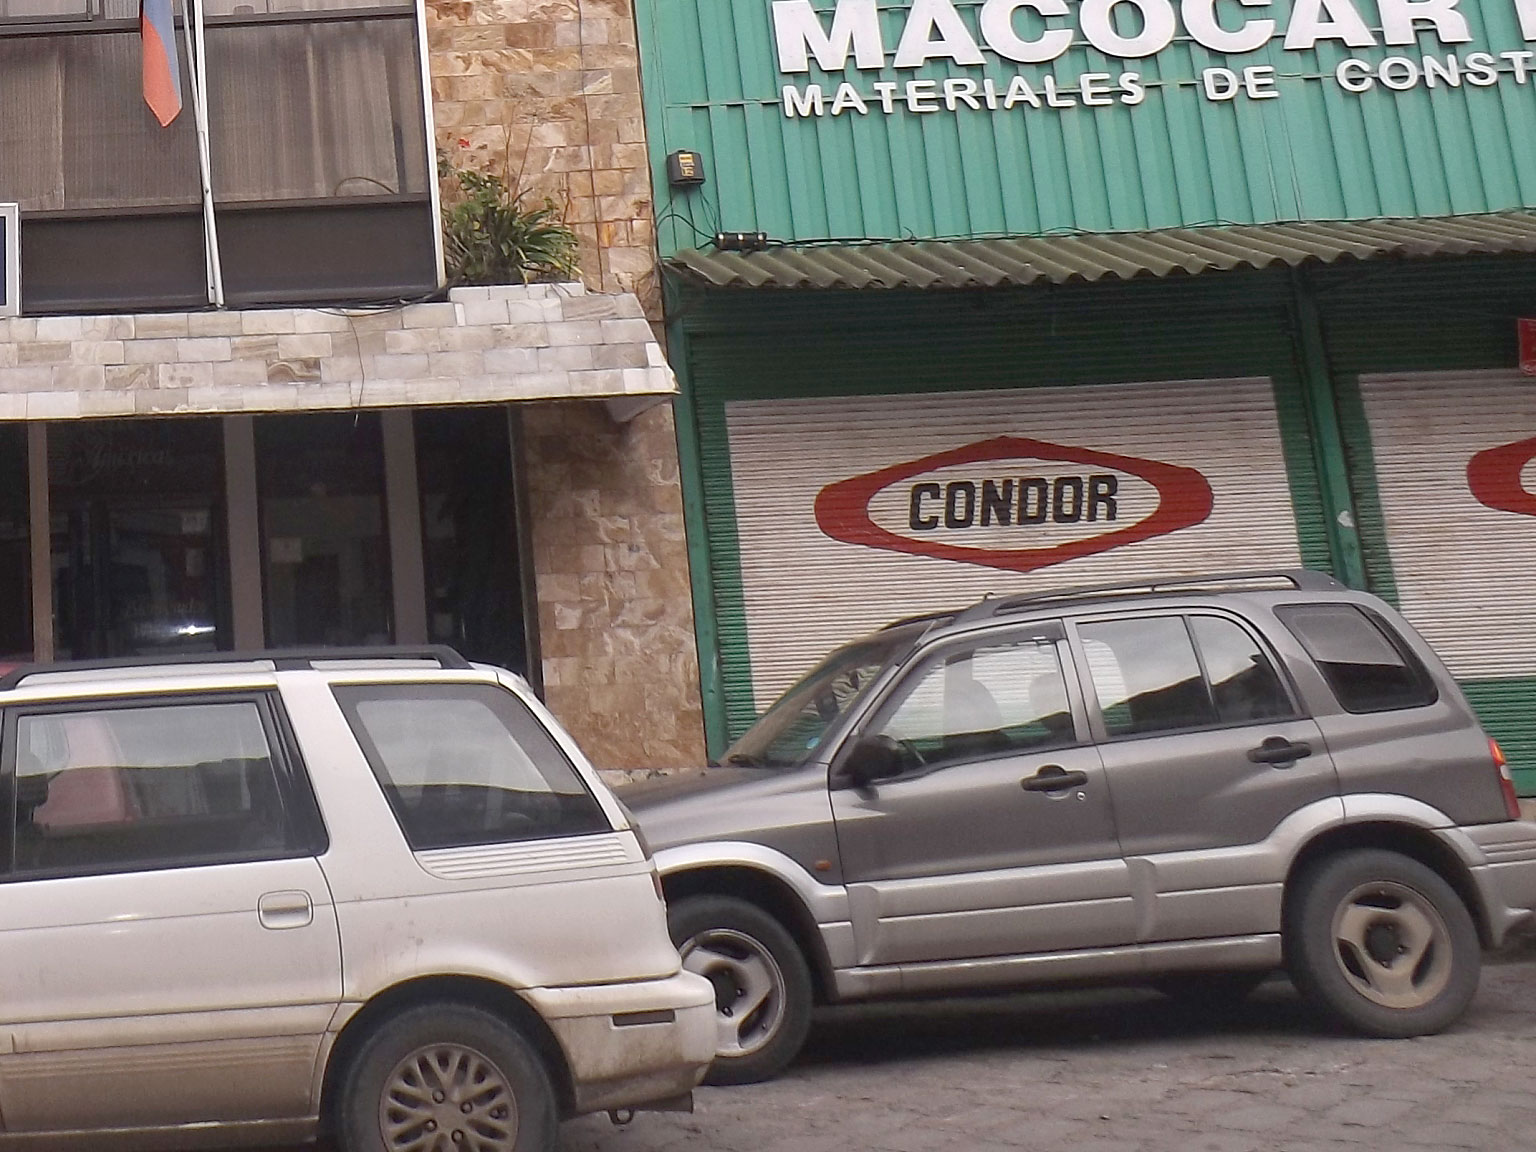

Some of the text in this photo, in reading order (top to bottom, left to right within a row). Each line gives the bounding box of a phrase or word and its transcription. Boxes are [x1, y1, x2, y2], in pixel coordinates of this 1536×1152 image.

[781, 71, 1146, 119] MATERIALES
[1203, 64, 1280, 102] DE
[909, 474, 1119, 531] CONDOR
